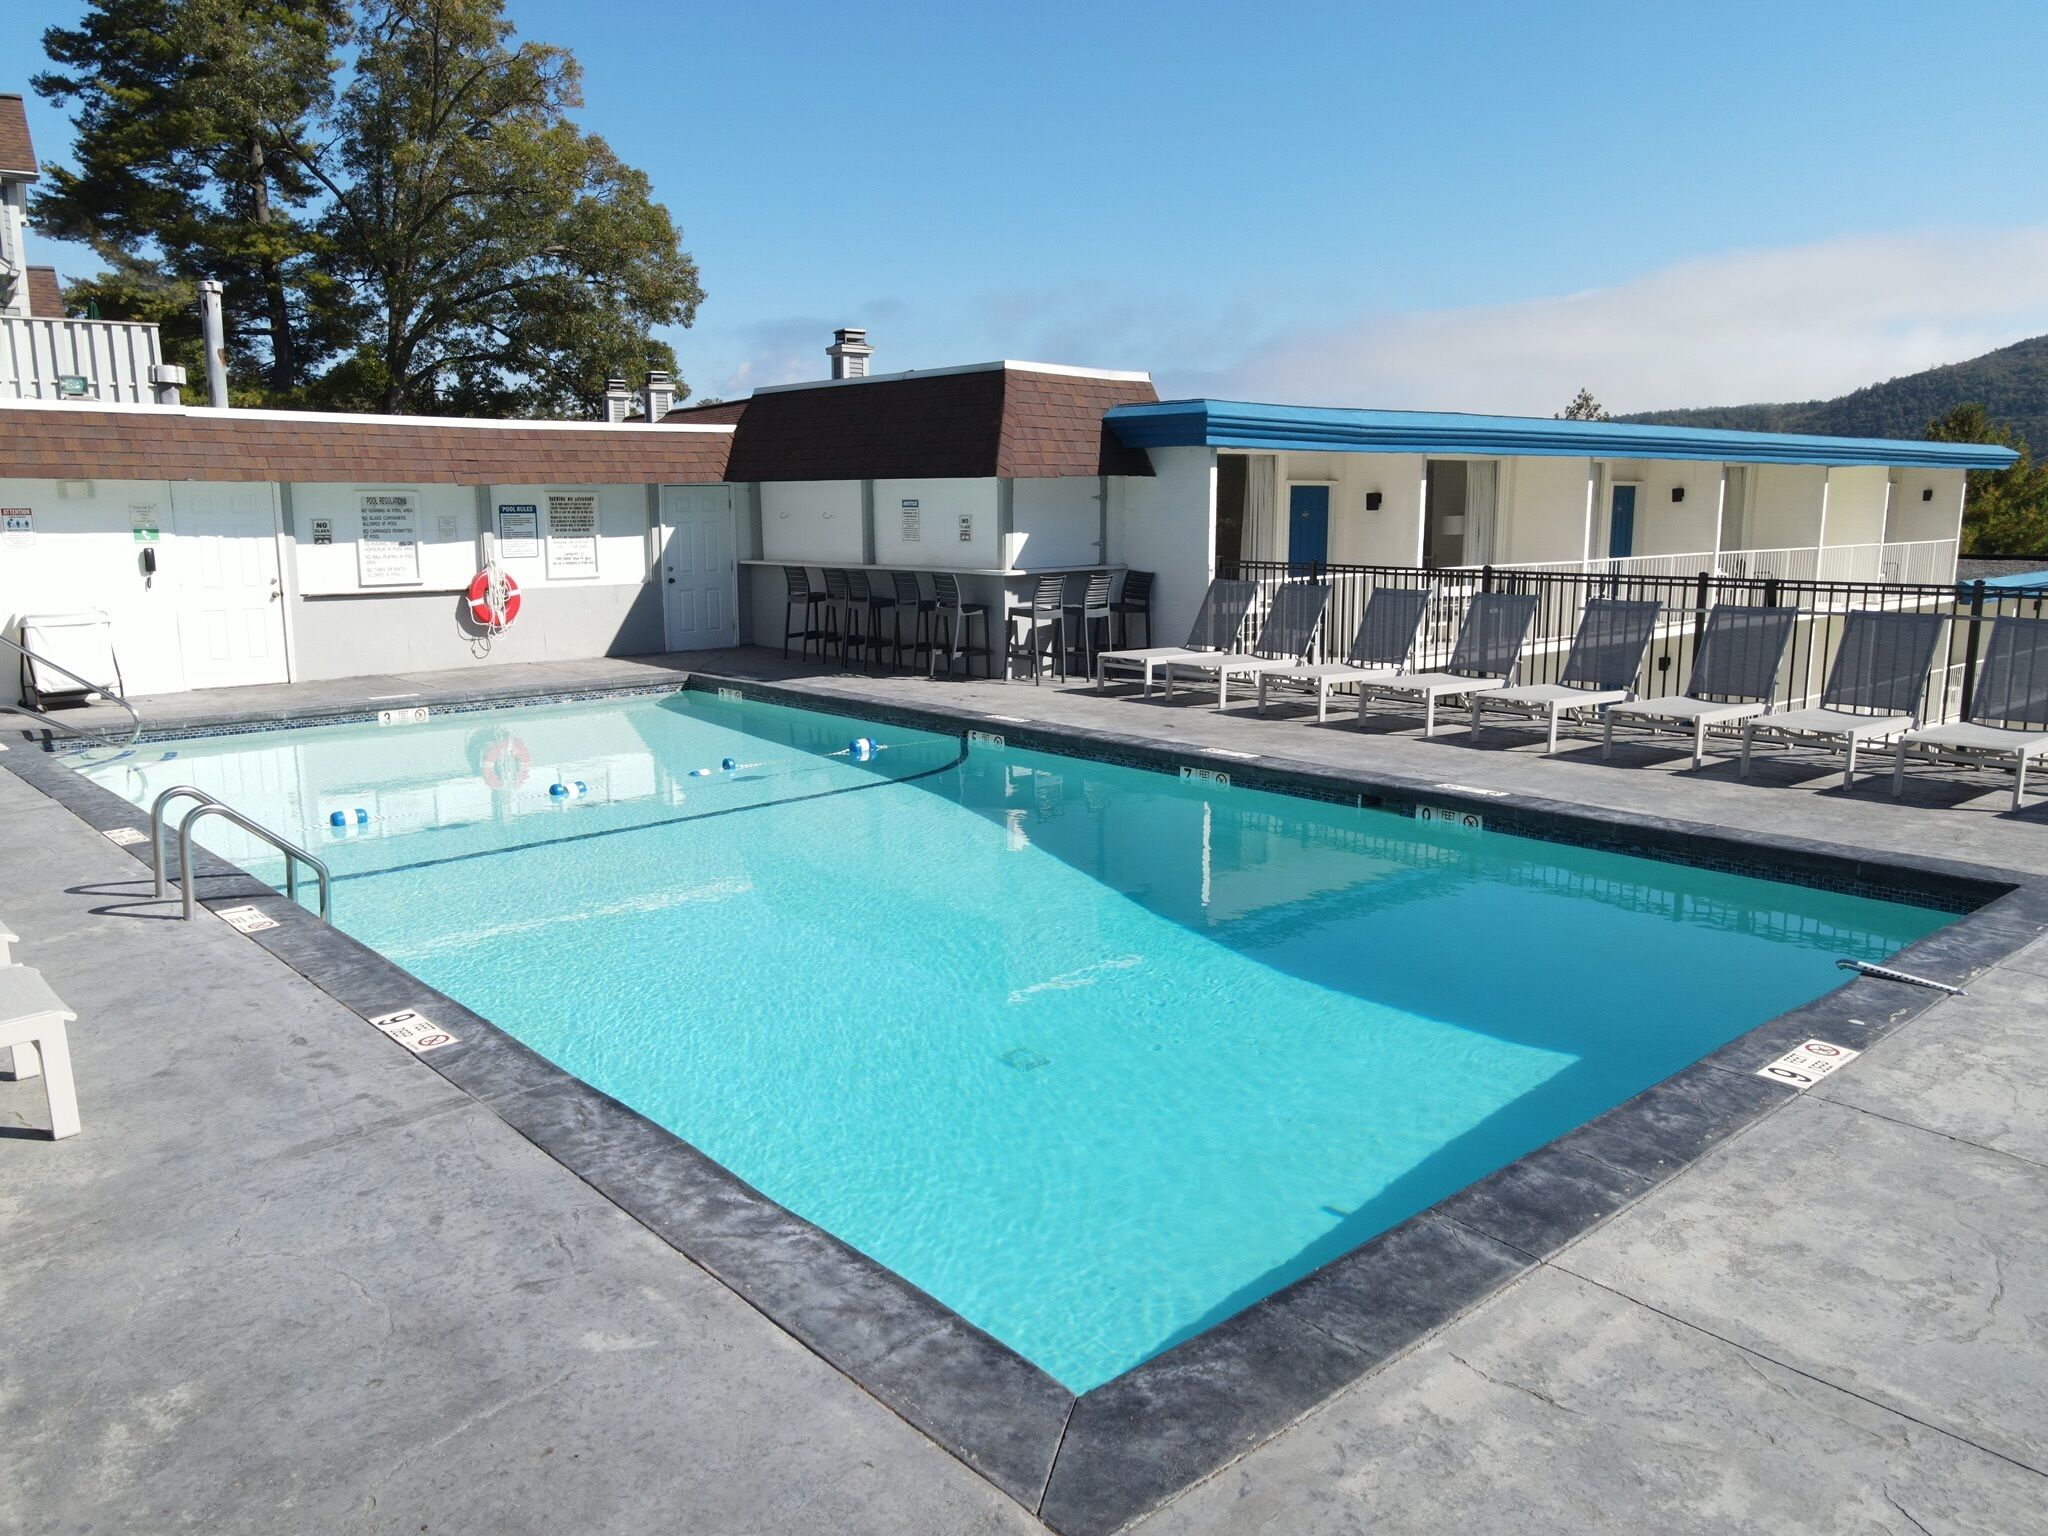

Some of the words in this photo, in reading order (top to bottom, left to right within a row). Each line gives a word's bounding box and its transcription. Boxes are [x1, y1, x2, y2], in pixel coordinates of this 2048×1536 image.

[366, 497, 378, 505] POOL
[379, 497, 407, 505] REGULATIONS
[1184, 768, 1192, 778] 7
[1200, 770, 1210, 779] FEET
[1442, 810, 1455, 820] FEET
[412, 1022, 436, 1032] FEET
[390, 1027, 414, 1038] DEEP
[1783, 1053, 1807, 1064] FEET
[1808, 1060, 1833, 1072] DEEP
